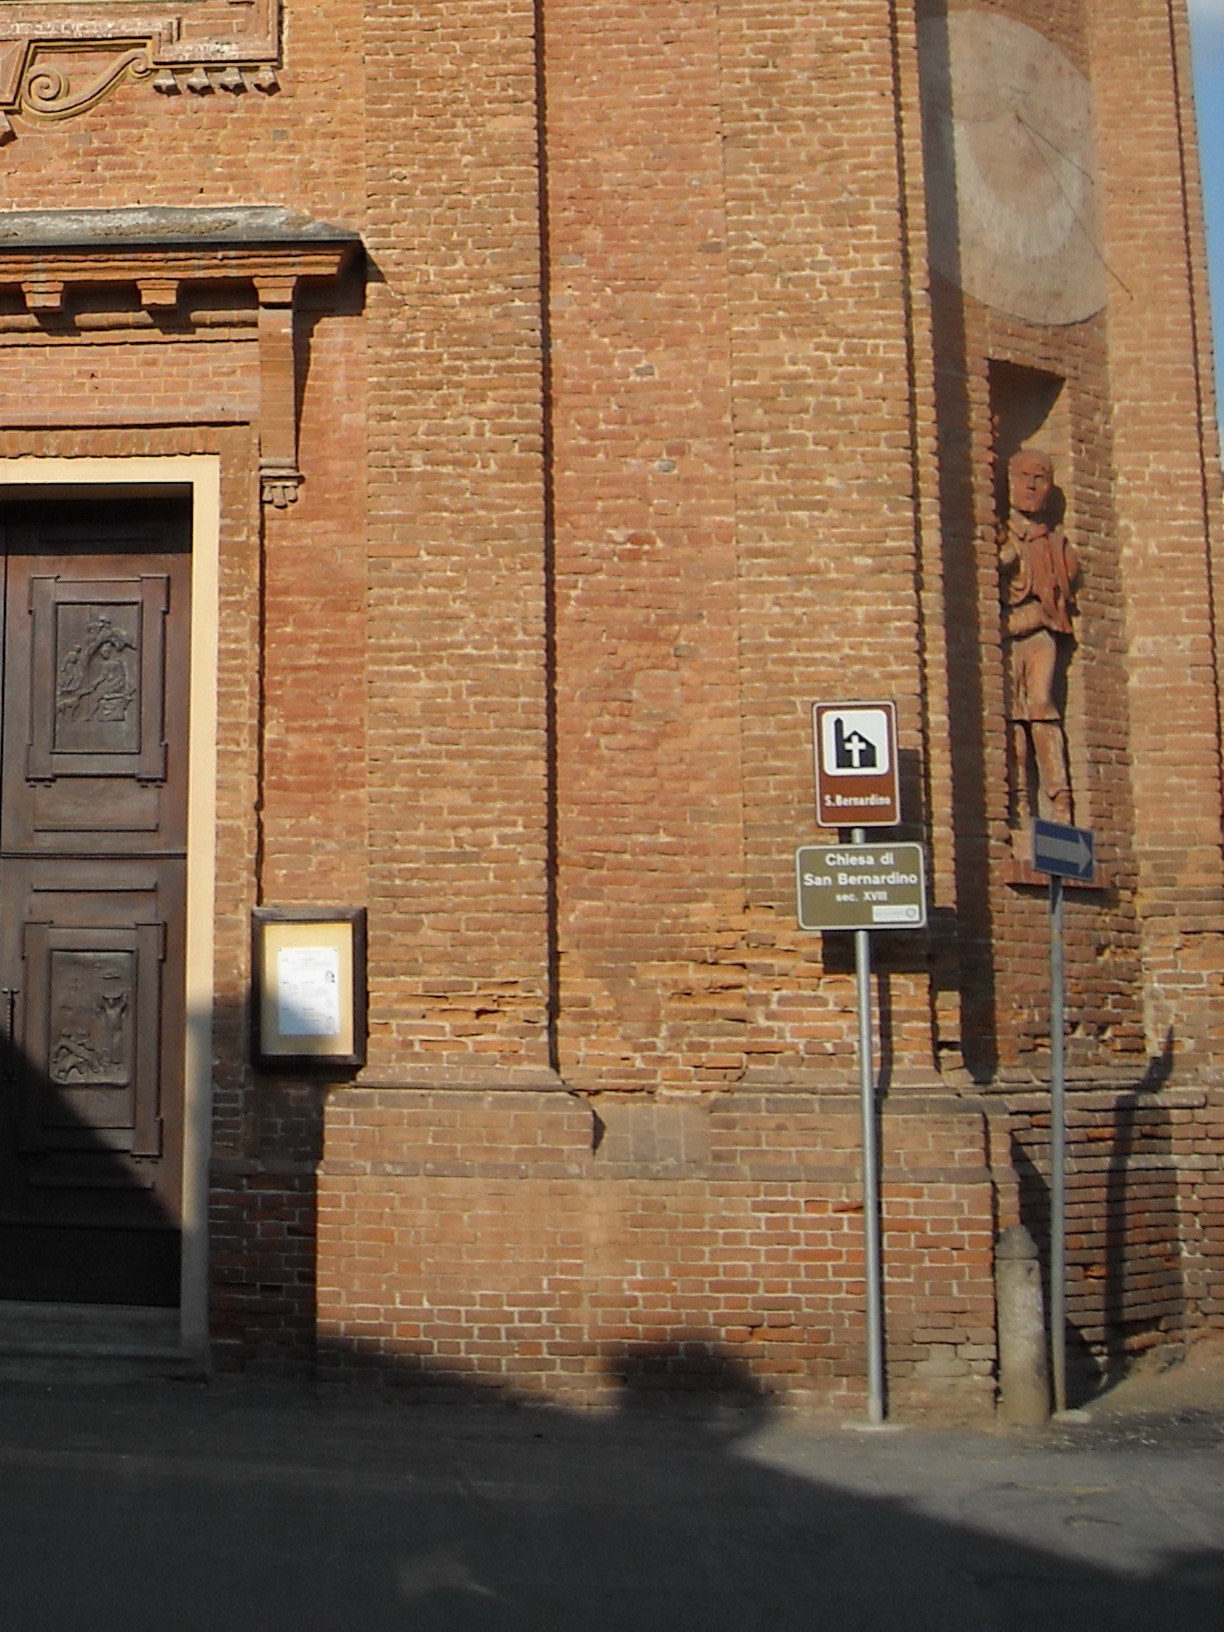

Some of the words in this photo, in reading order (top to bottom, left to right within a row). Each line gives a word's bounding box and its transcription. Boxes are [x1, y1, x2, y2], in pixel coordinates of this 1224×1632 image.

[825, 852, 875, 866] Chiesa
[880, 851, 894, 865] di
[804, 873, 832, 886] San
[838, 871, 918, 885] Bernardino
[835, 892, 859, 902] sec.
[863, 891, 888, 901] XVIII
